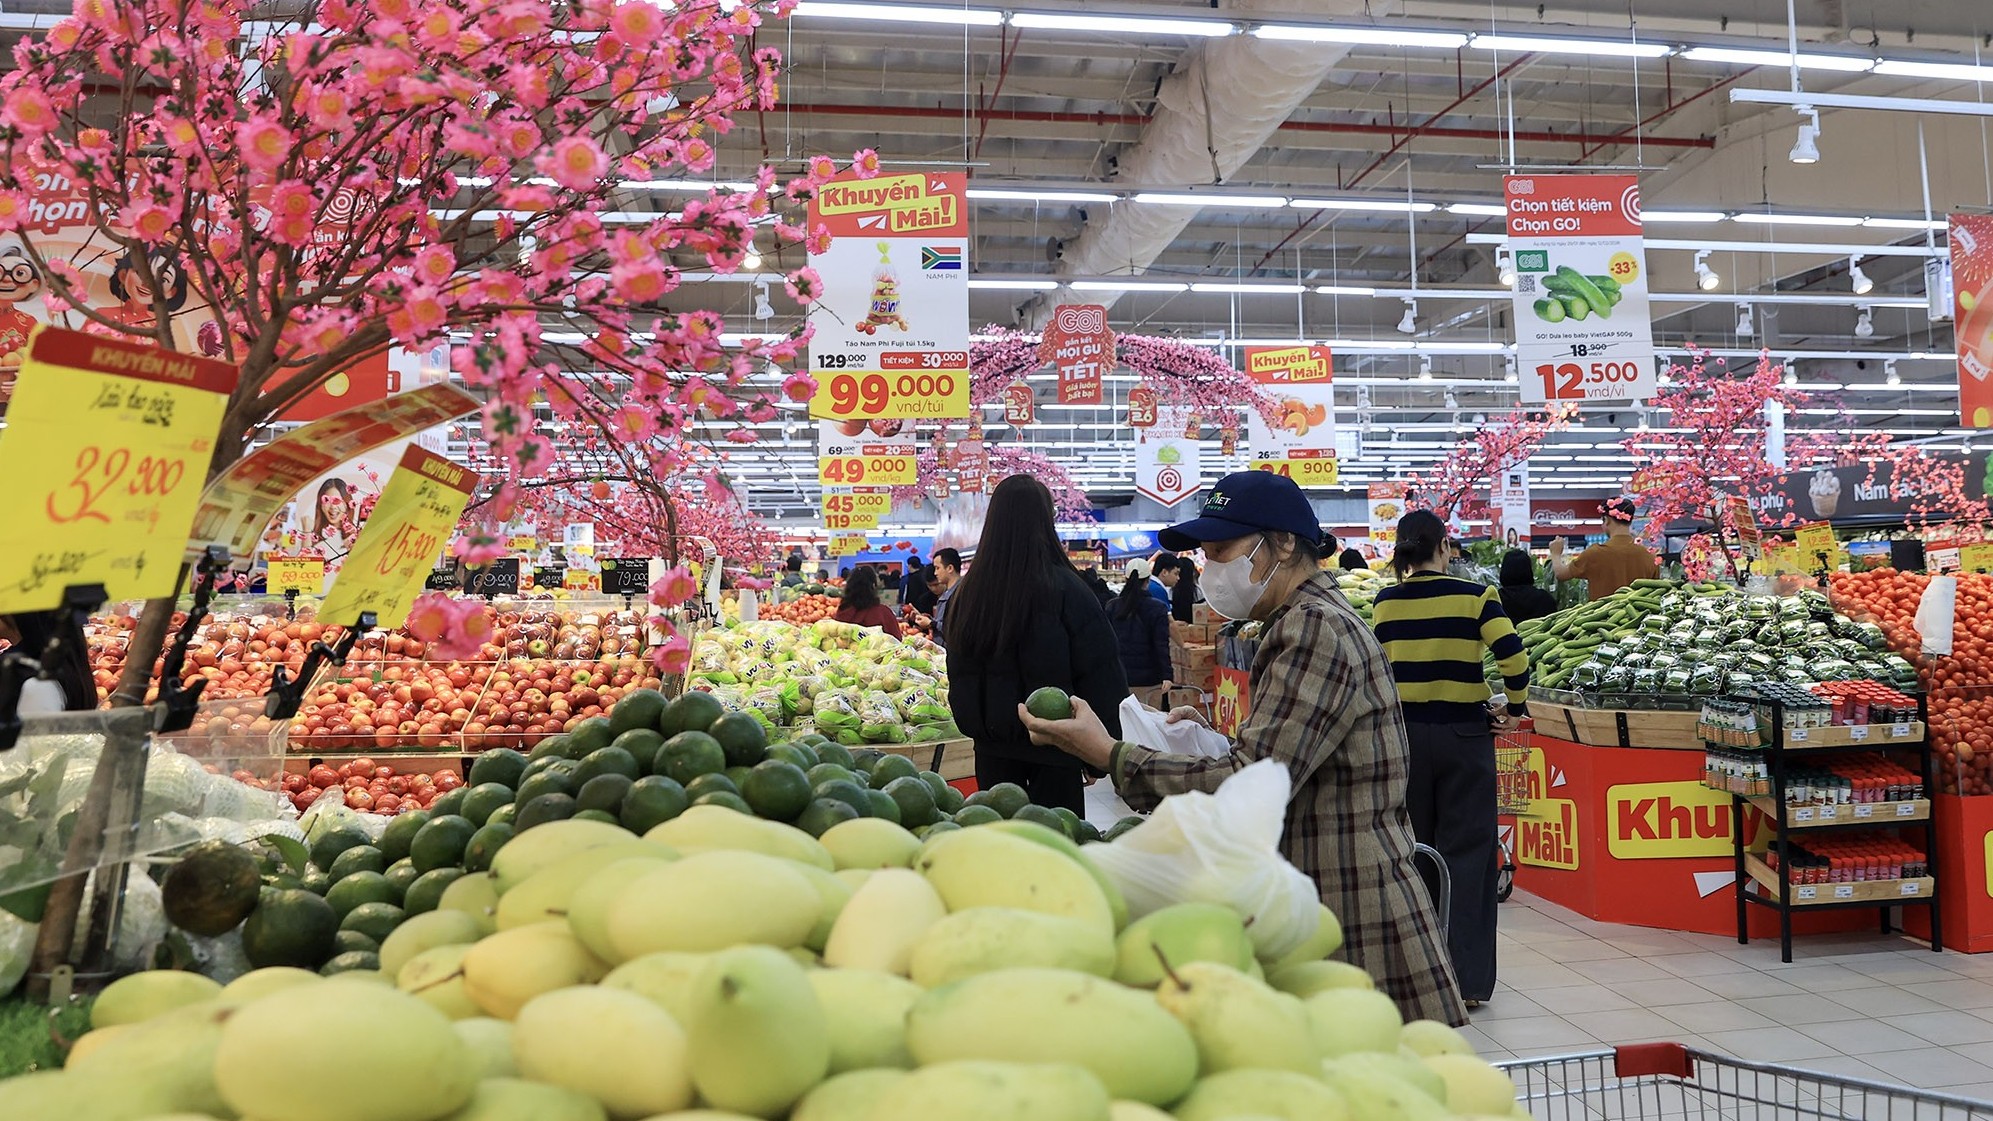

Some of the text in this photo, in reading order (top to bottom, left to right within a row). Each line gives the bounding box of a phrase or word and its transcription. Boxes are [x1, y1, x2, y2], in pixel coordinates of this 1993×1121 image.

[824, 179, 919, 207] Khuyến
[896, 196, 951, 229] Mãi!
[1510, 196, 1613, 215] Chọn tiết kiệm
[1512, 217, 1582, 234] Chọn GO!
[1058, 308, 1104, 335] GO!
[883, 356, 898, 365] TIẾT
[1056, 343, 1102, 360] MỌI GU
[1254, 350, 1307, 368] Khuyến
[1060, 357, 1099, 381] TẾT
[1293, 360, 1324, 380] Mãi!
[1535, 361, 1639, 400] 12.500
[830, 374, 955, 415] 99.000
[896, 398, 944, 414] vnd/túi
[823, 459, 906, 483] 49.000
[1521, 803, 1574, 865] Mãi!
